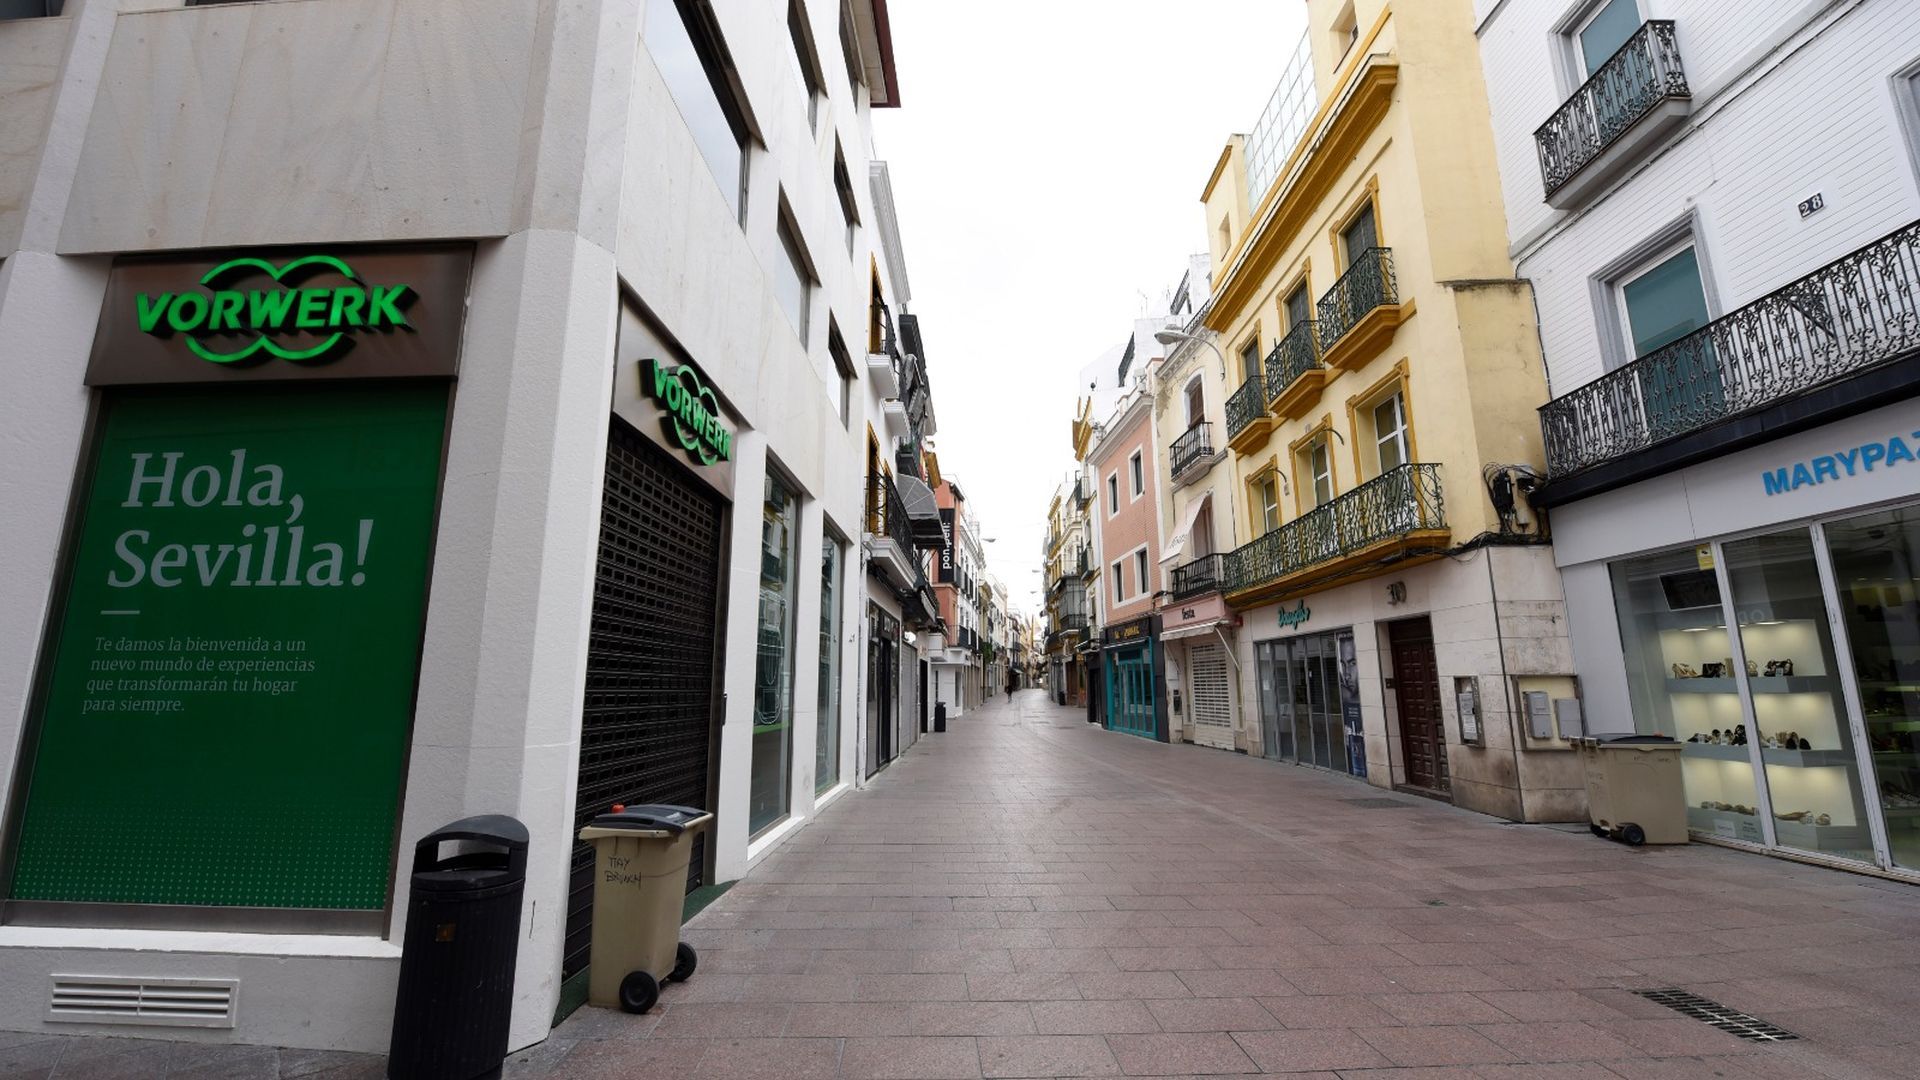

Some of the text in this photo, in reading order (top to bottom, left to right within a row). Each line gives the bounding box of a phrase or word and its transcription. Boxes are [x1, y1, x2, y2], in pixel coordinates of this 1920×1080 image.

[1800, 195, 1822, 217] 28
[135, 284, 411, 333] VORWERK
[652, 357, 732, 463] VORWERK
[121, 448, 304, 524] Hola,
[107, 519, 374, 588] Sevilla!
[1386, 581, 1407, 606] 30
[95, 637, 306, 652] Te damos la bienvenida a un
[91, 656, 315, 675] nuevo mundo de experiencias
[86, 676, 298, 696] que transformarán tu hogar
[82, 696, 185, 715] para siempre.
